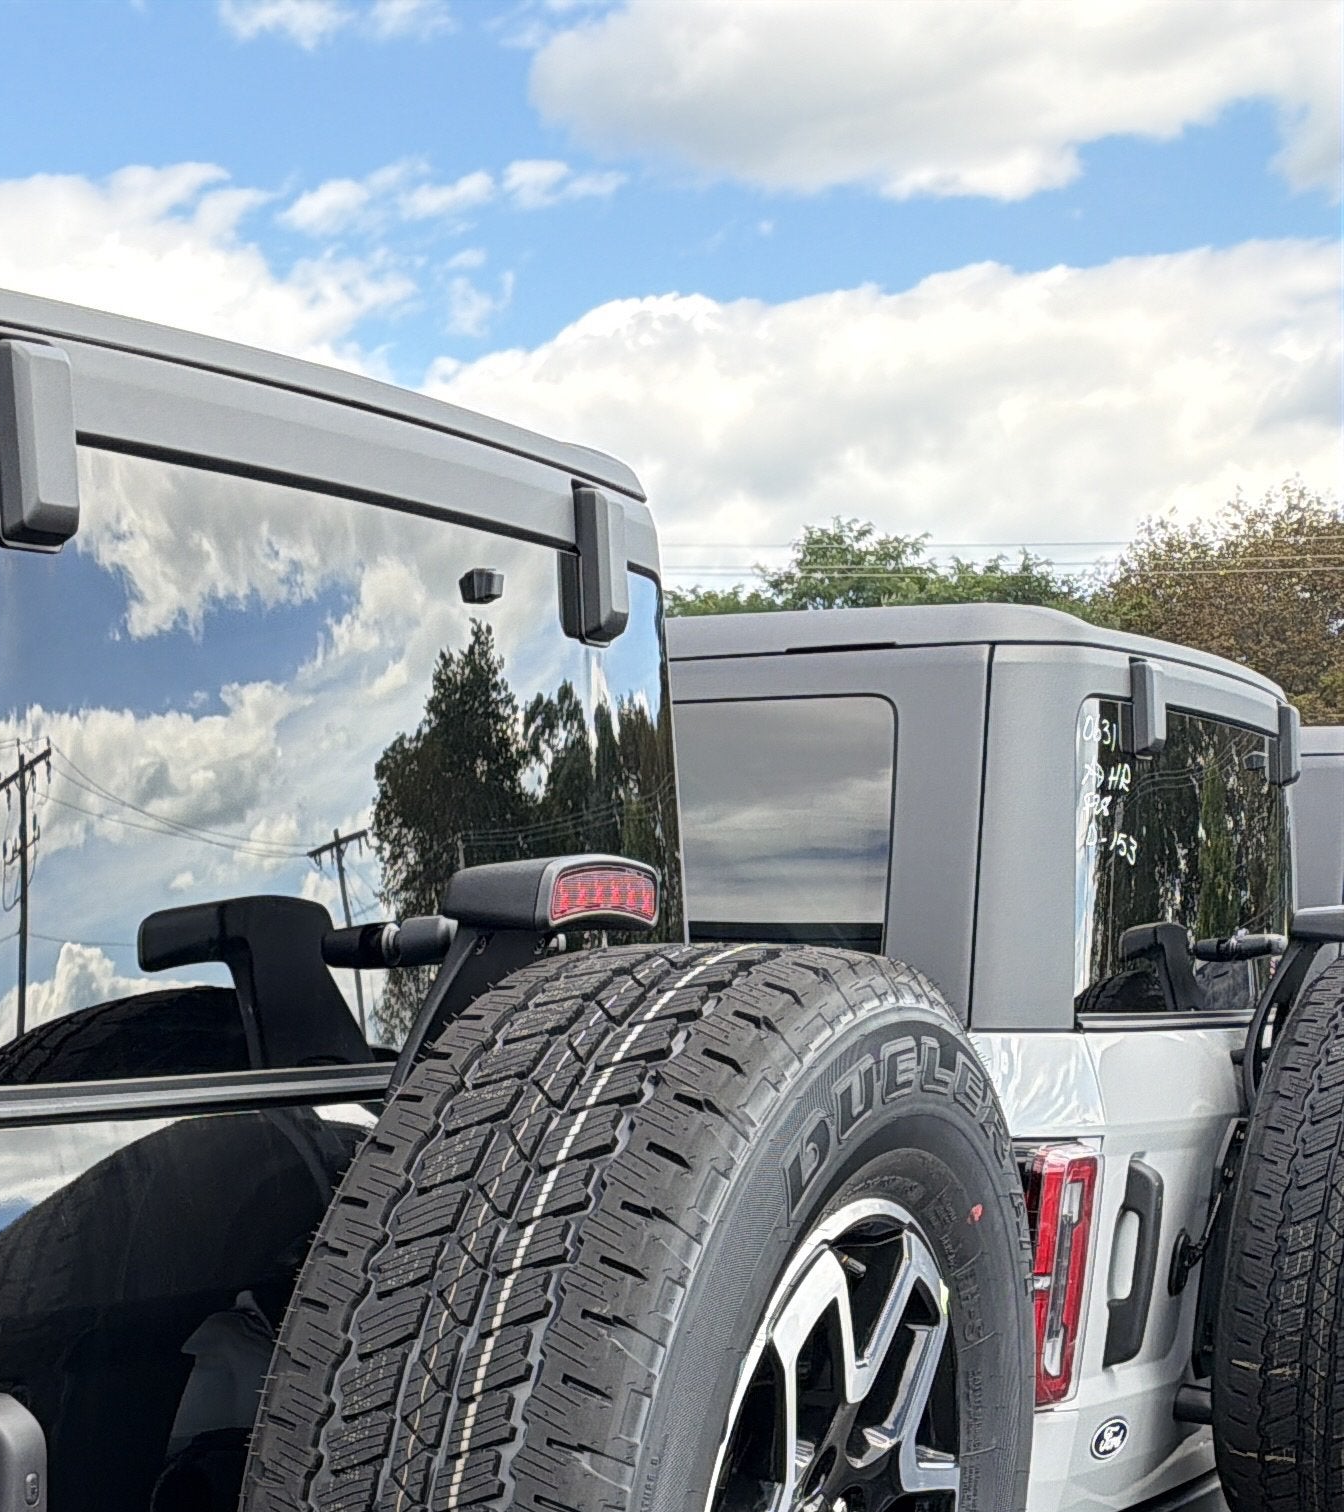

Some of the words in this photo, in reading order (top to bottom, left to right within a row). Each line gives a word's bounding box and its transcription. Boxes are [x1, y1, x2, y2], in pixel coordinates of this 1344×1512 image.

[1082, 713, 1117, 753] 0631
[1108, 762, 1132, 792] HR
[782, 1034, 1015, 1227] DUELER
[1098, 1424, 1125, 1453] Ford
